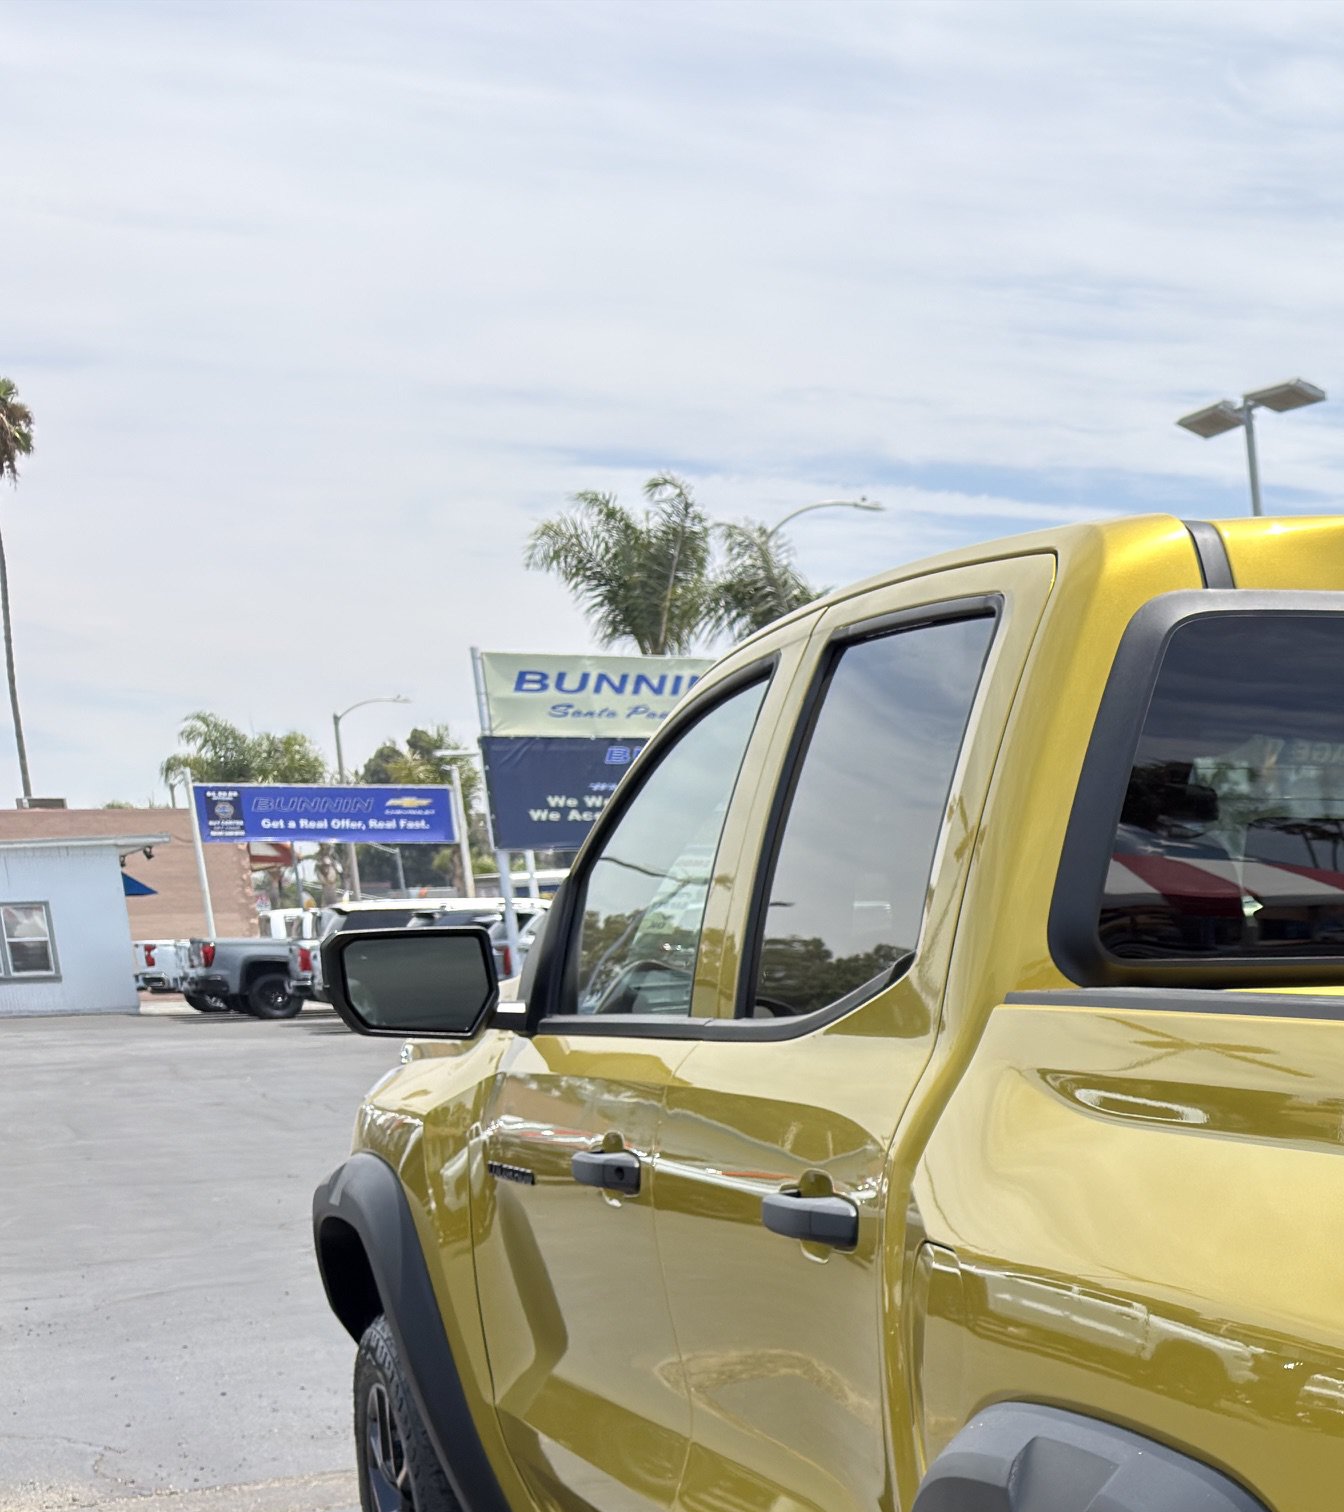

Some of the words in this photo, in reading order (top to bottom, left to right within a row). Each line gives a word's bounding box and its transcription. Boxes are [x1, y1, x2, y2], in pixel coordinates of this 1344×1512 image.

[513, 670, 702, 696] BUNNI
[549, 703, 617, 720] Santa
[252, 796, 374, 813] BUNNIN
[546, 795, 578, 808] We
[528, 809, 561, 821] We
[261, 818, 285, 829] Get
[288, 820, 297, 829] a
[299, 818, 328, 829] Real
[331, 818, 366, 831] Offer,
[369, 818, 397, 829] Real
[400, 818, 430, 829] Fast.
